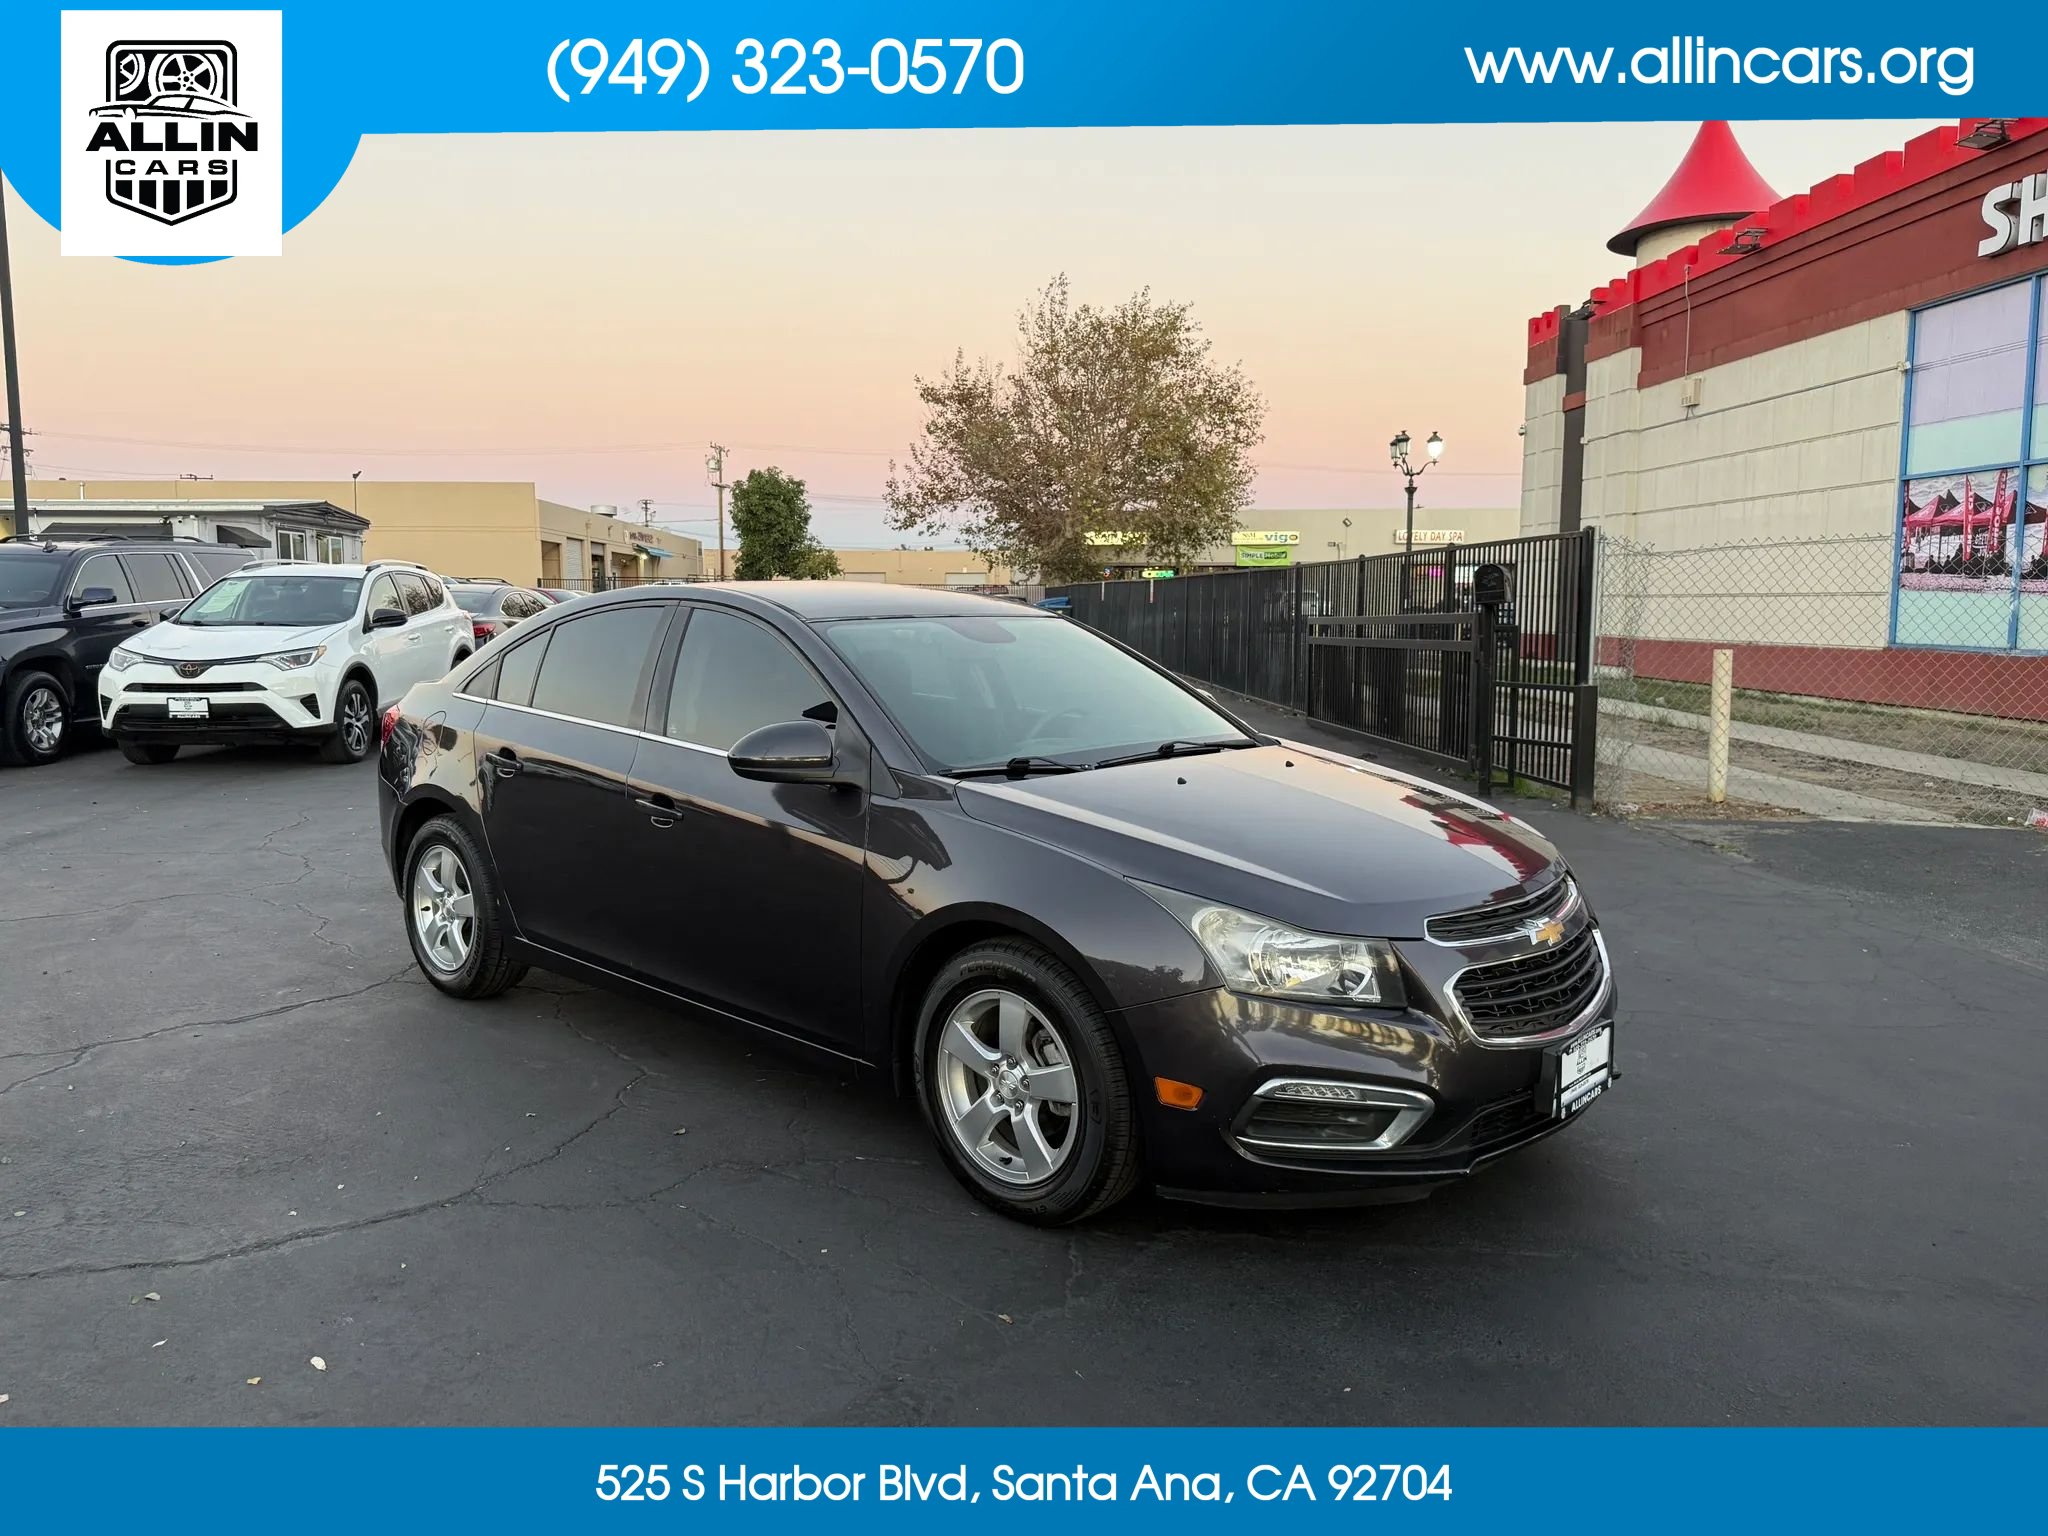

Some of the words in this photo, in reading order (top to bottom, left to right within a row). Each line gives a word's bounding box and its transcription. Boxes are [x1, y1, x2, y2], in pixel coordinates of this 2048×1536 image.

[1264, 532, 1298, 543] vigo
[1398, 531, 1428, 542] LOELY
[1430, 531, 1446, 542] DAY
[1448, 531, 1463, 542] SPA
[1571, 1085, 1602, 1112] ALLINCARS
